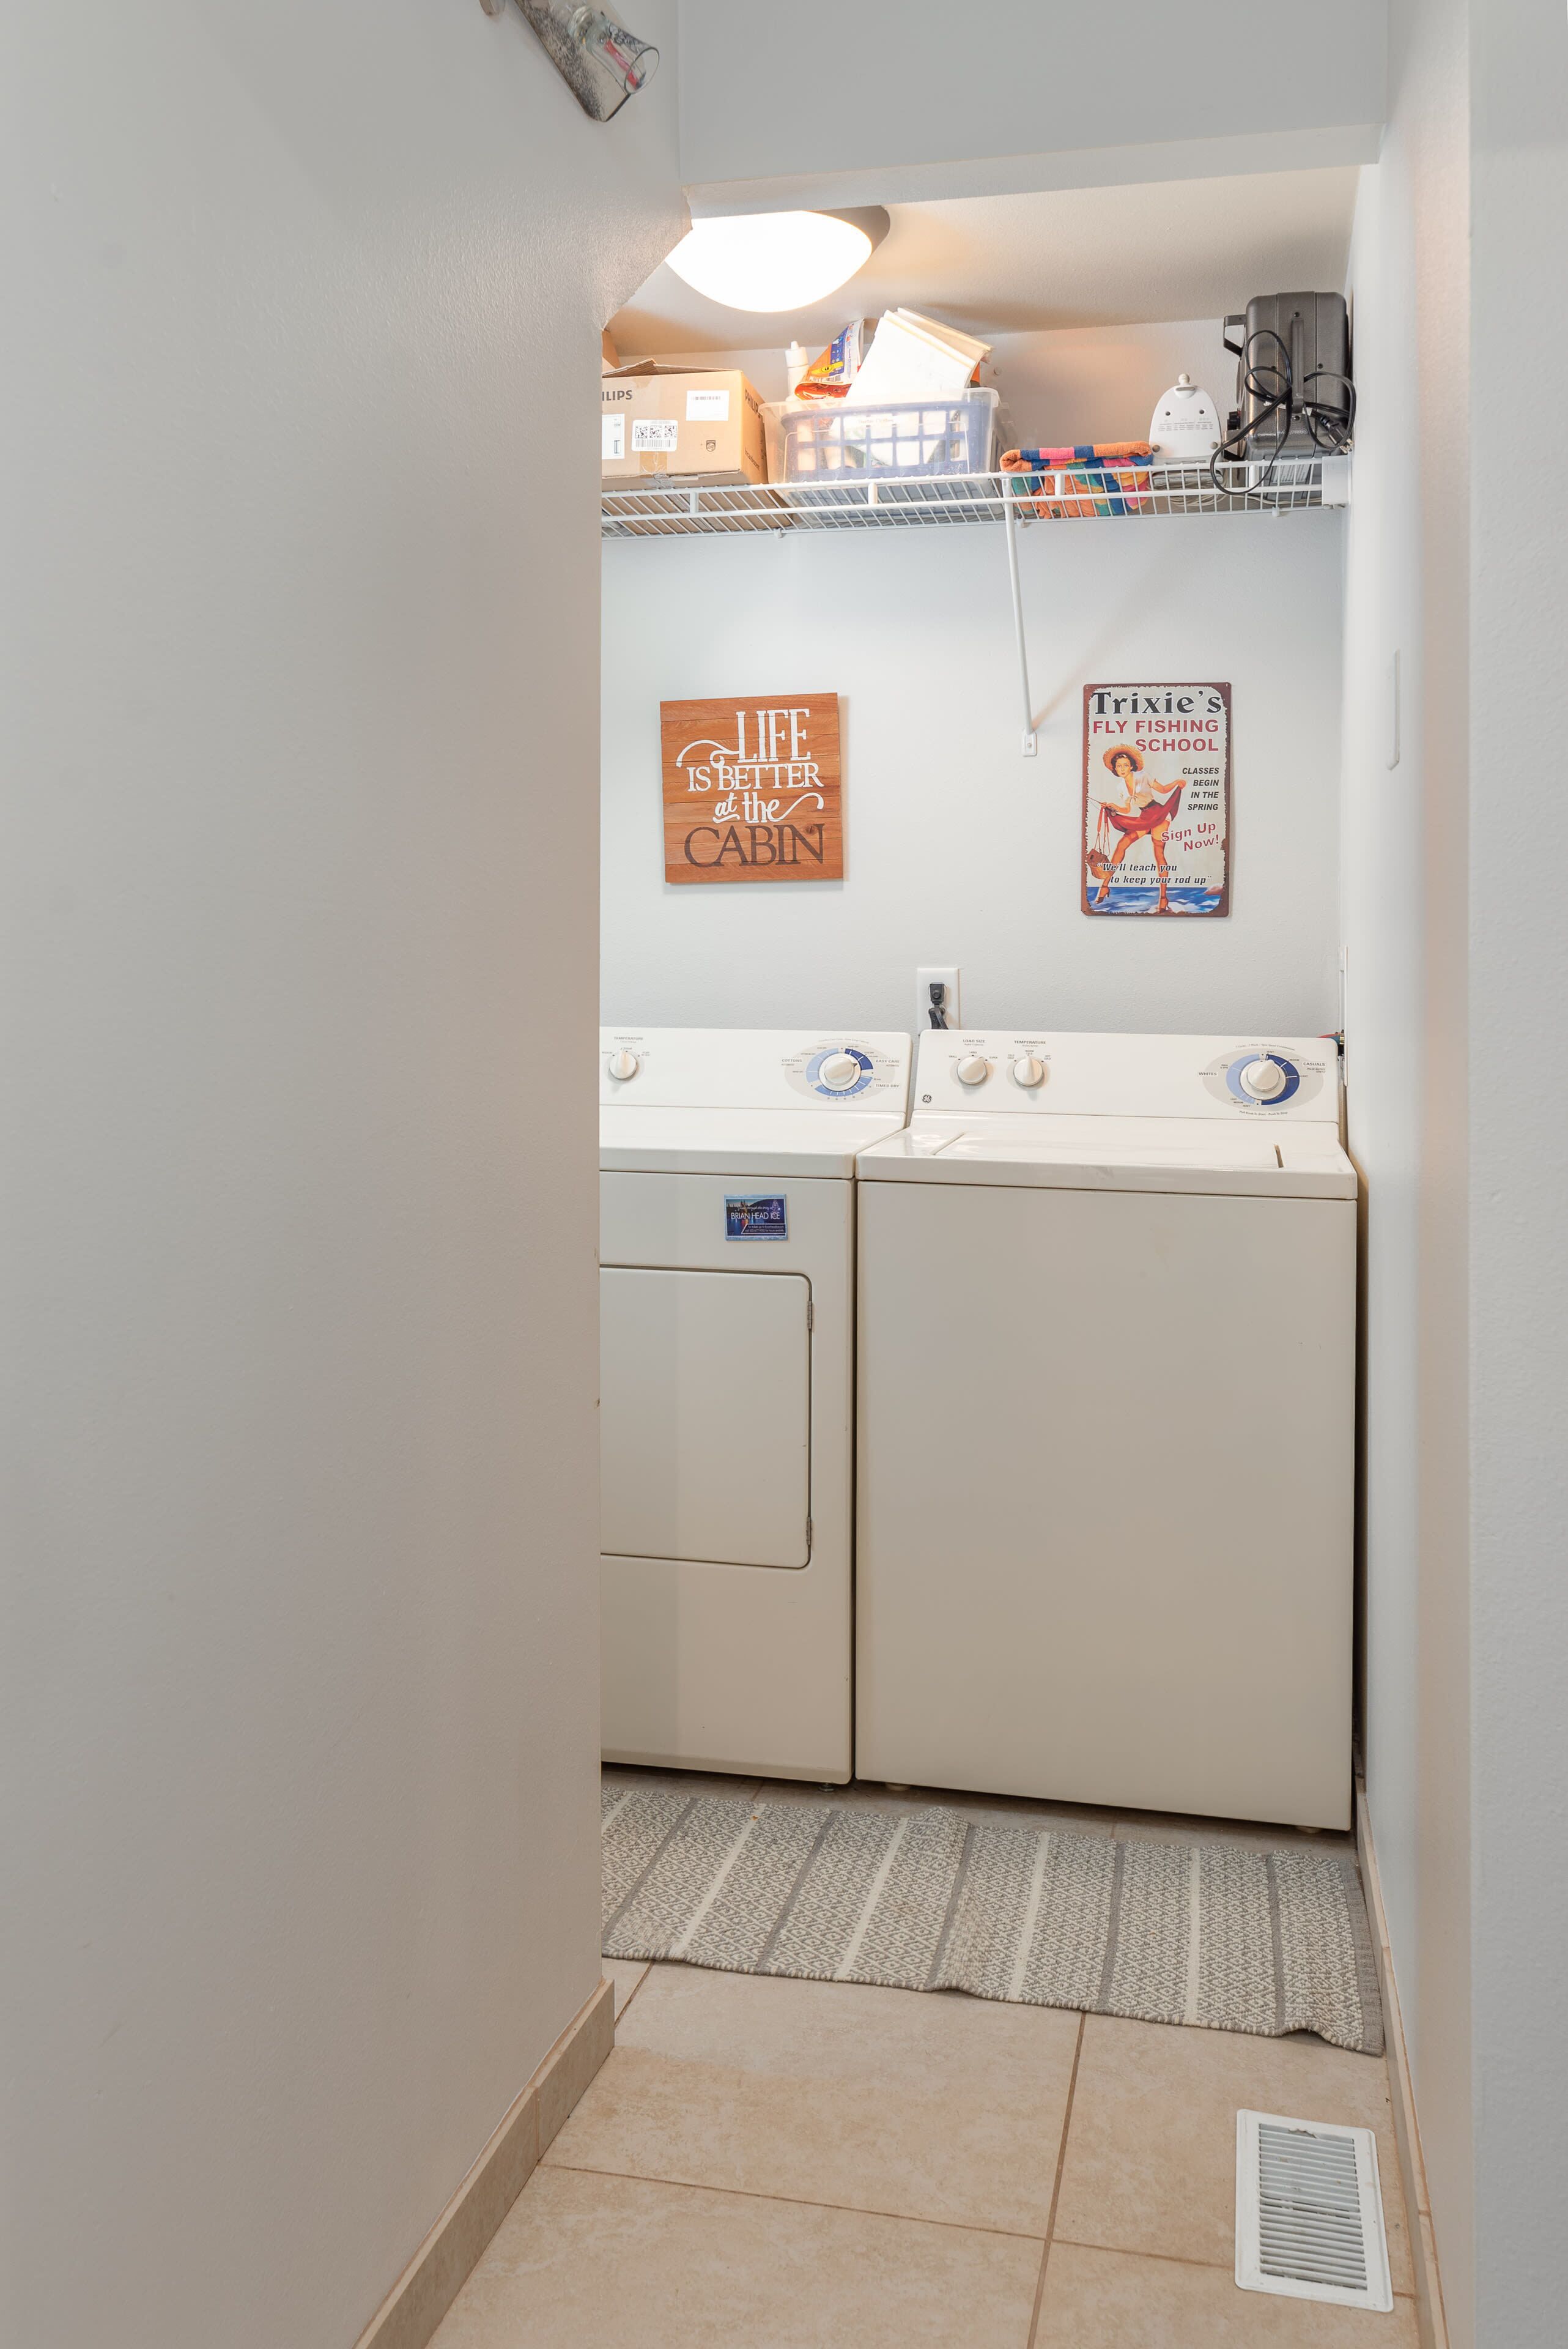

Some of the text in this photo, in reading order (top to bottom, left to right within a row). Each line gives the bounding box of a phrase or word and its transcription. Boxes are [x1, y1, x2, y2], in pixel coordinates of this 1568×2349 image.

[1091, 690, 1222, 714] Trixie's
[736, 708, 812, 763] LIFE
[1093, 719, 1219, 734] FLY FISHING
[1135, 738, 1219, 752] SCHOOL
[686, 762, 825, 792] IS BETTER
[714, 792, 785, 823] at the
[1161, 822, 1216, 842] Sign Up
[684, 823, 825, 868] CABIN
[1183, 834, 1219, 852] Now!
[1129, 863, 1156, 872] teach
[1159, 864, 1178, 874] you
[1123, 876, 1147, 885] keep
